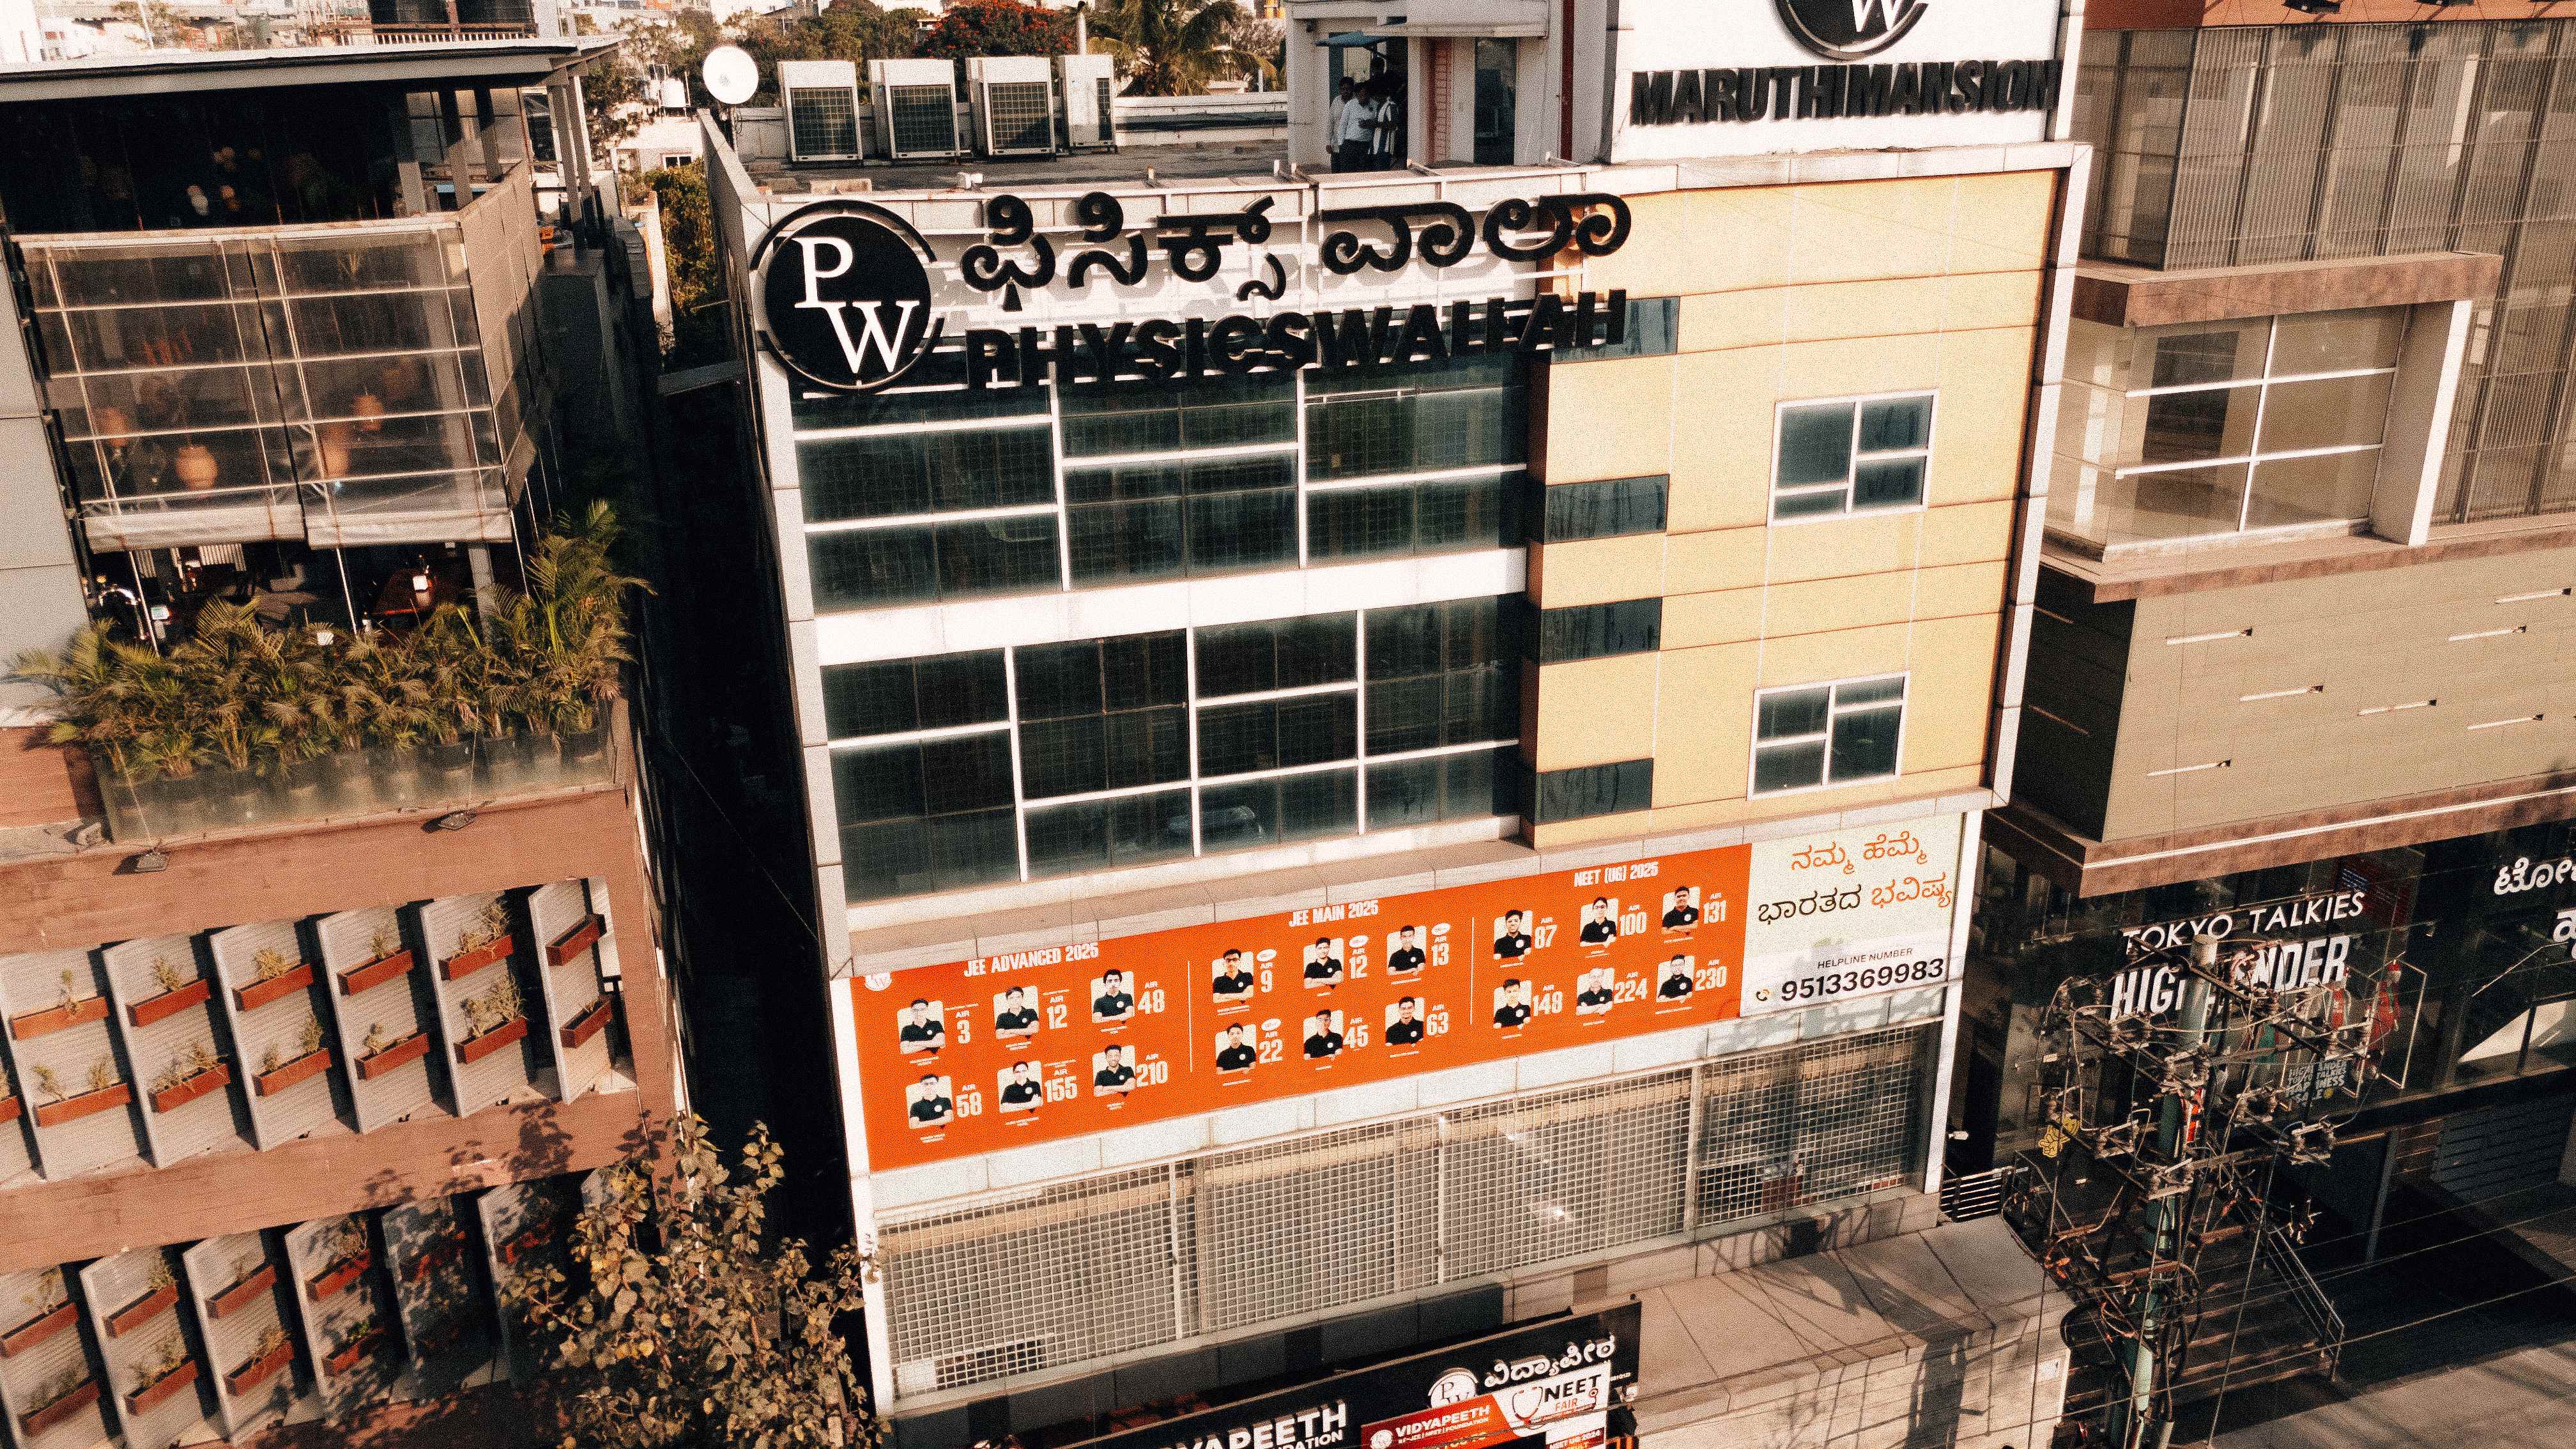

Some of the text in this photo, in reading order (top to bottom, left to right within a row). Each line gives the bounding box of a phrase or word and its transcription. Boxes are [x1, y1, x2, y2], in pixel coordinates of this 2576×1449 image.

[1630, 59, 2057, 125] MARUTHI MANSION
[1321, 193, 1631, 275] ವಾಲಾ
[1791, 831, 1928, 875] ನಮ್ಮ ಹೆಮ್ಮೆ
[1574, 861, 1659, 887] NEET (UG) 2025
[1758, 871, 1952, 925] ಭಾರತದ ಭವಿಷ್ಯ
[1289, 900, 1378, 927] JEE MAIN 2025
[1620, 912, 1647, 937] 100
[1703, 900, 1726, 924] 131
[2123, 914, 2233, 955] TOKYO
[2250, 891, 2365, 933] TALKIES
[1534, 924, 1557, 949] 87
[964, 942, 1098, 977] JEE ADVANCED 2025
[1349, 955, 1367, 979] 12
[1431, 942, 1449, 966] 13
[1817, 947, 1913, 969] HELPLINE NUMBER
[1261, 970, 1272, 993] 9
[1614, 978, 1648, 1004] 224
[1695, 966, 1727, 992] 230
[1781, 958, 1944, 1001] 9513369983
[2109, 936, 2350, 1022] HIGNDER
[1137, 989, 1165, 1015] 48
[1533, 991, 1563, 1016] 148
[1046, 1004, 1068, 1029] 12
[1427, 1011, 1449, 1036] 63
[957, 1020, 970, 1044] 3
[1343, 1024, 1368, 1048] 45
[1259, 1039, 1283, 1064] 22
[1137, 1061, 1168, 1087] 210
[2285, 1075, 2345, 1098] HAPINESS
[1045, 1076, 1078, 1103] 155
[956, 1092, 982, 1117] 58
[1544, 1374, 1602, 1402] NEET
[1555, 1397, 1578, 1411] FAIR
[1395, 1405, 1490, 1438] VIDYAPEETH
